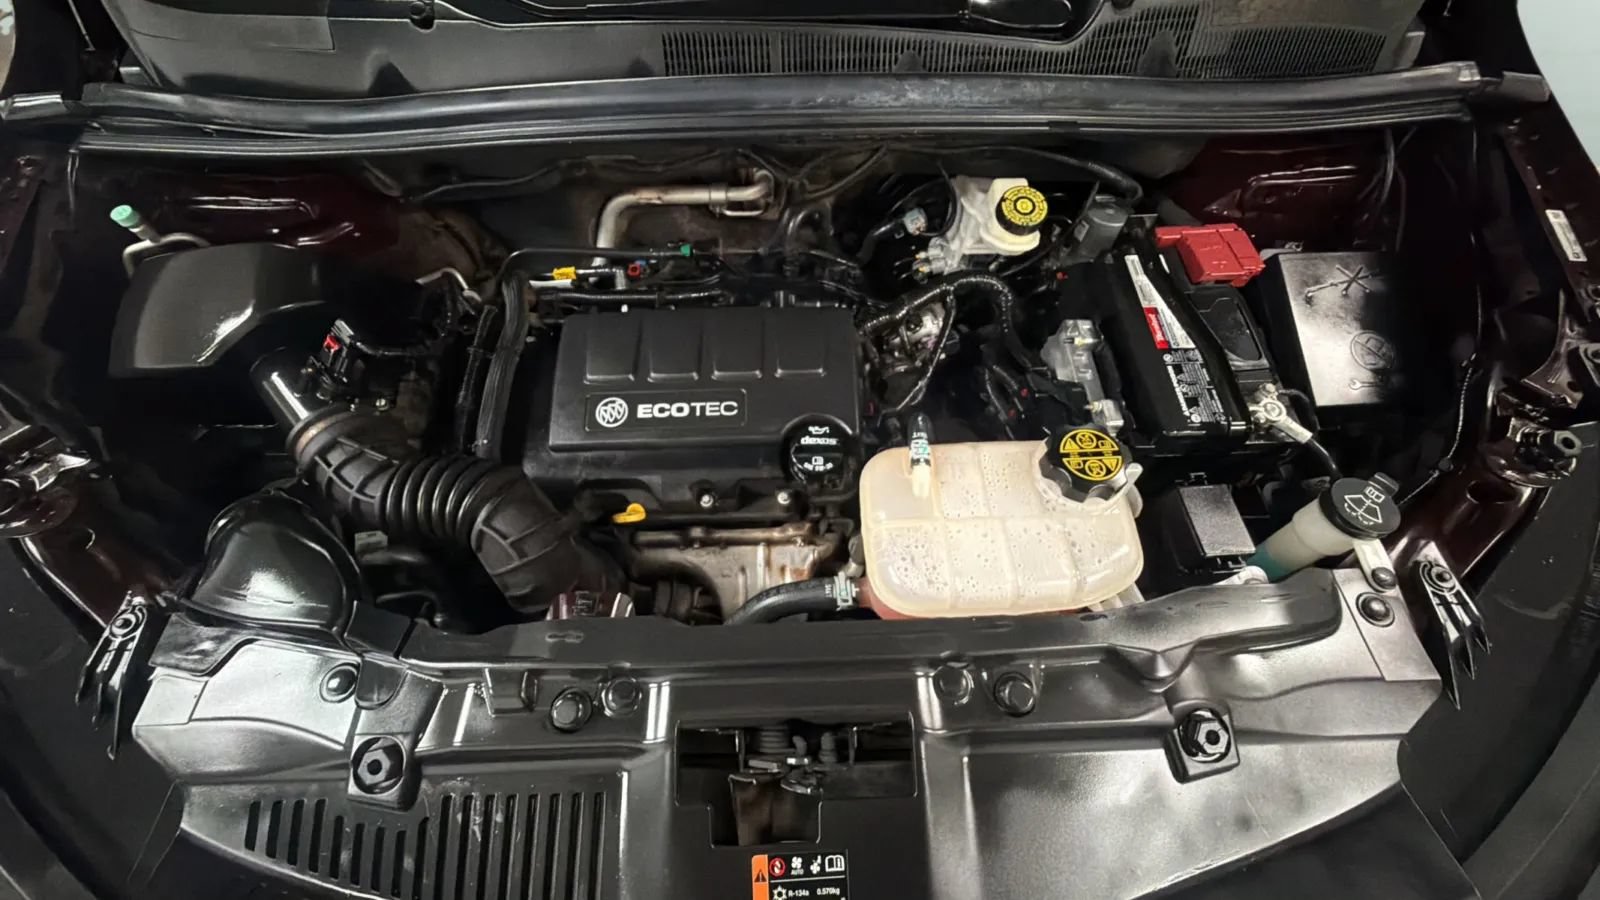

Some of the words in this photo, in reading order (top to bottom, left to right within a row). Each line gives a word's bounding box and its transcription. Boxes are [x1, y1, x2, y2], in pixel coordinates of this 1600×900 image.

[636, 401, 739, 419] ECOTEC
[800, 435, 837, 445] dexos
[788, 889, 810, 898] R-134a
